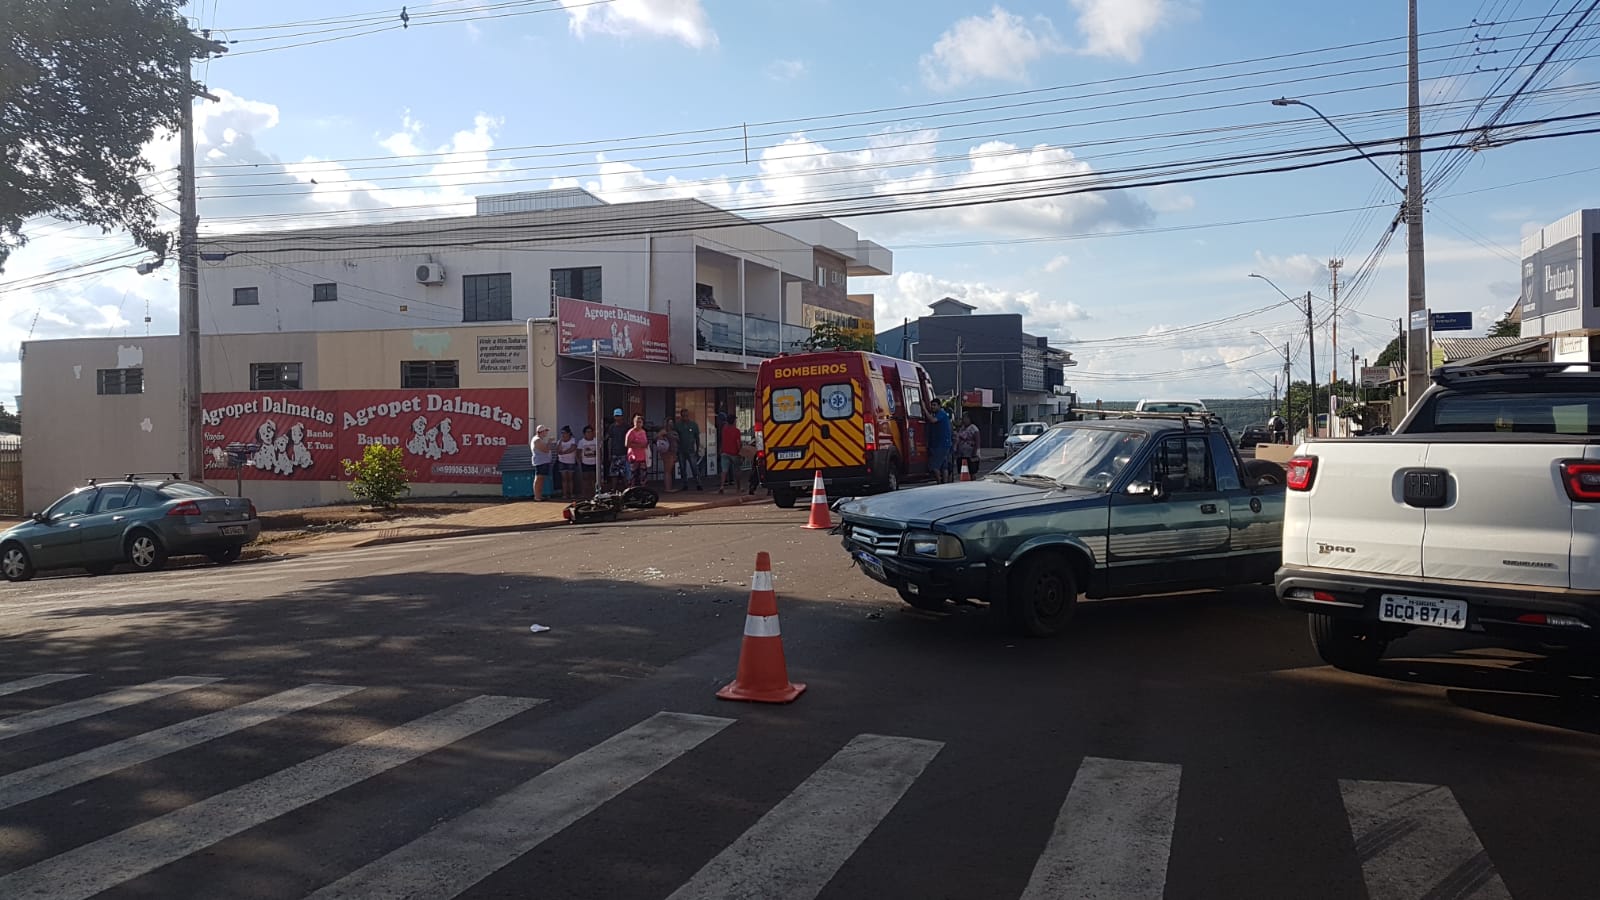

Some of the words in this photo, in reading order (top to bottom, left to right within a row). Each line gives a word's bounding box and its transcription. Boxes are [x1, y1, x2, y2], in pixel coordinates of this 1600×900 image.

[584, 306, 616, 320] Agropet
[617, 308, 650, 326] Dalmatas
[774, 363, 848, 379] BOMBEIROS
[201, 400, 258, 426] Agropet
[262, 396, 334, 425] Dalmatas
[342, 396, 421, 430] Agropet
[426, 394, 523, 431] Dalmatas
[306, 429, 334, 438] Banho
[357, 433, 400, 446] Banho
[462, 434, 472, 446] E
[474, 433, 507, 446] Tosa
[315, 442, 334, 450] Tosa
[1406, 473, 1439, 497] FIAT
